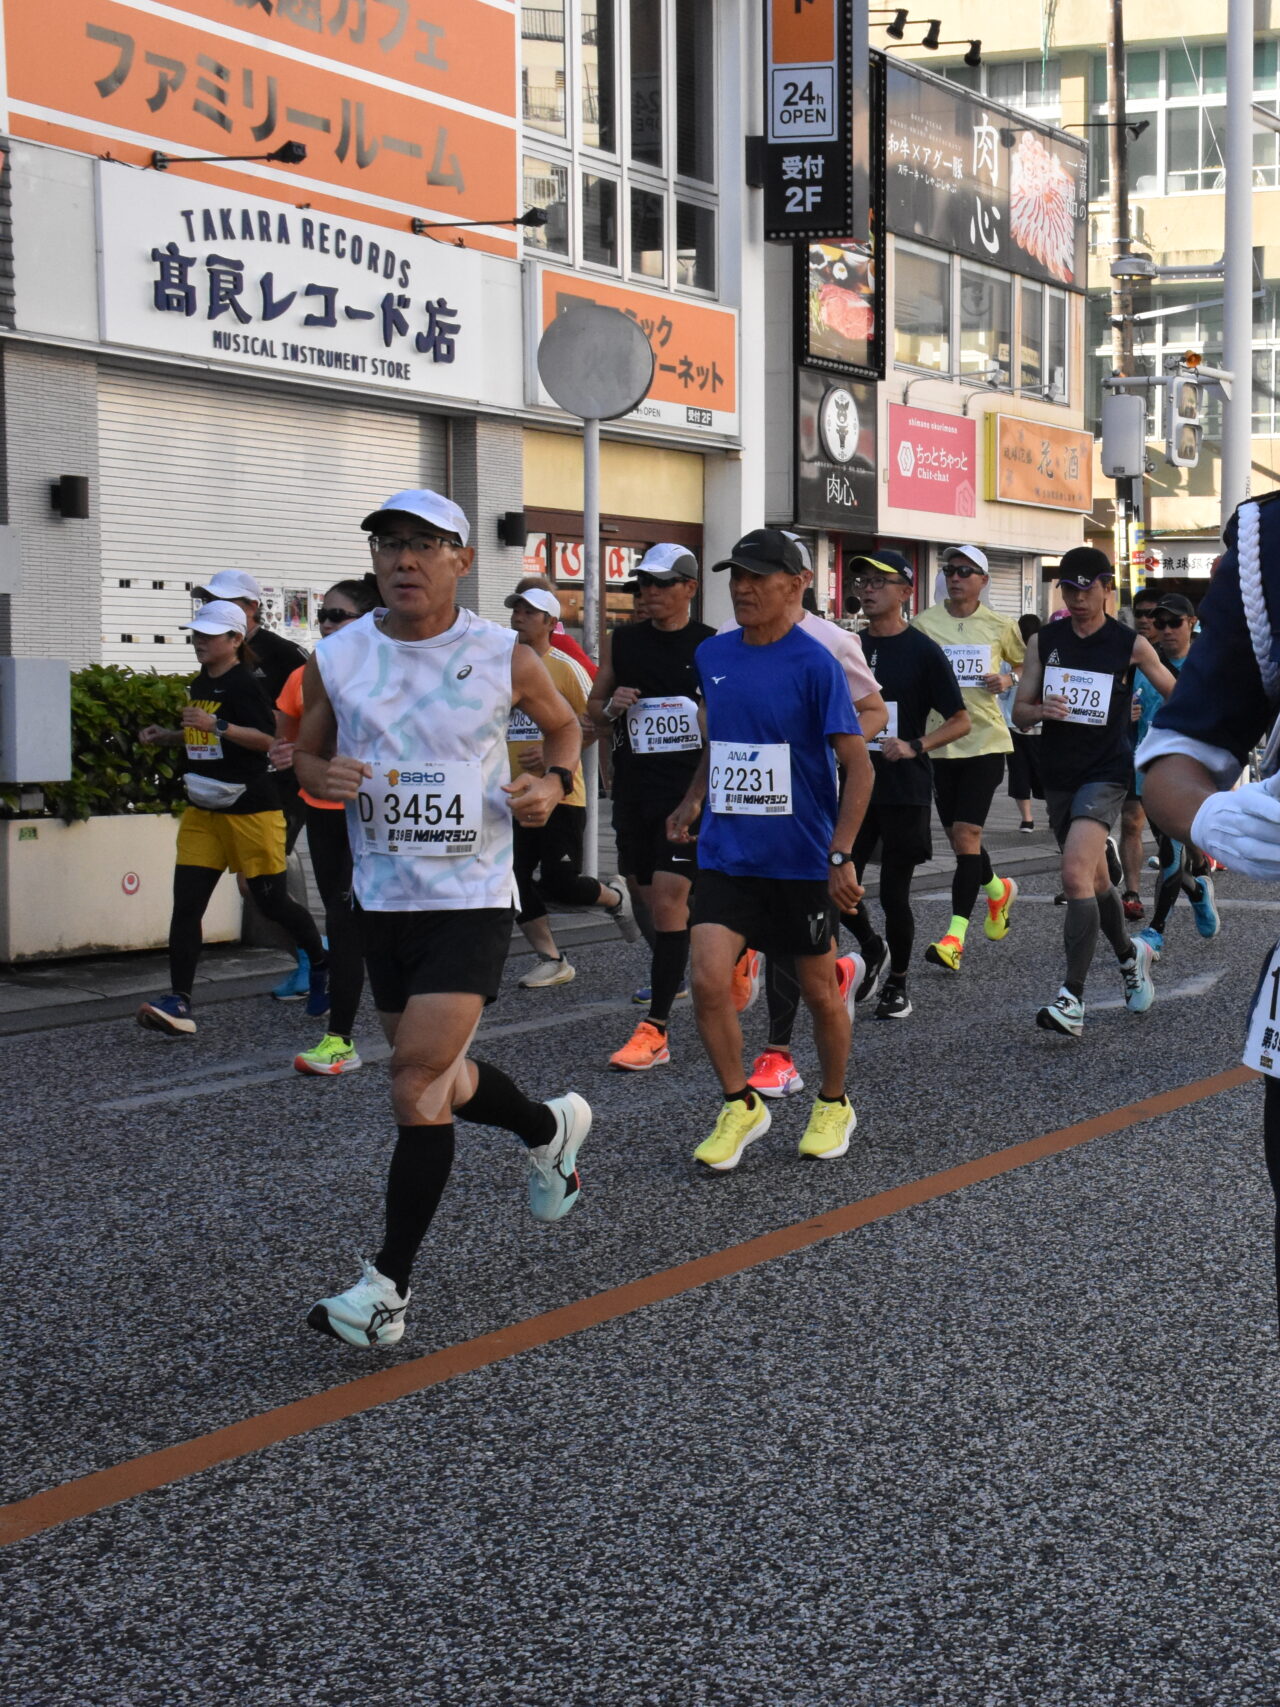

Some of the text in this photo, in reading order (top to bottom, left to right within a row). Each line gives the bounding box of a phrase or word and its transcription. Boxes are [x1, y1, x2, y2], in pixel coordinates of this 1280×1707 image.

[783, 81, 824, 107] 24h
[85, 21, 466, 195] ファミリールーム
[779, 108, 827, 125] OPEN
[781, 155, 825, 180] 受付
[970, 113, 1000, 254] 肉心
[784, 186, 823, 213] 2F
[181, 208, 411, 289] TAKARA RECORDS
[212, 330, 411, 380] MUSICAL INSTRUMENT STORE
[644, 407, 661, 417] OPEN
[916, 443, 968, 471] ちっとちゃっと
[917, 467, 949, 482] Chit-chat
[1070, 675, 1094, 684] sato
[629, 715, 690, 737] C 2605
[727, 751, 748, 761] ANA
[400, 771, 446, 783] sato
[711, 766, 774, 792] C 2231
[358, 791, 464, 825] D 3454
